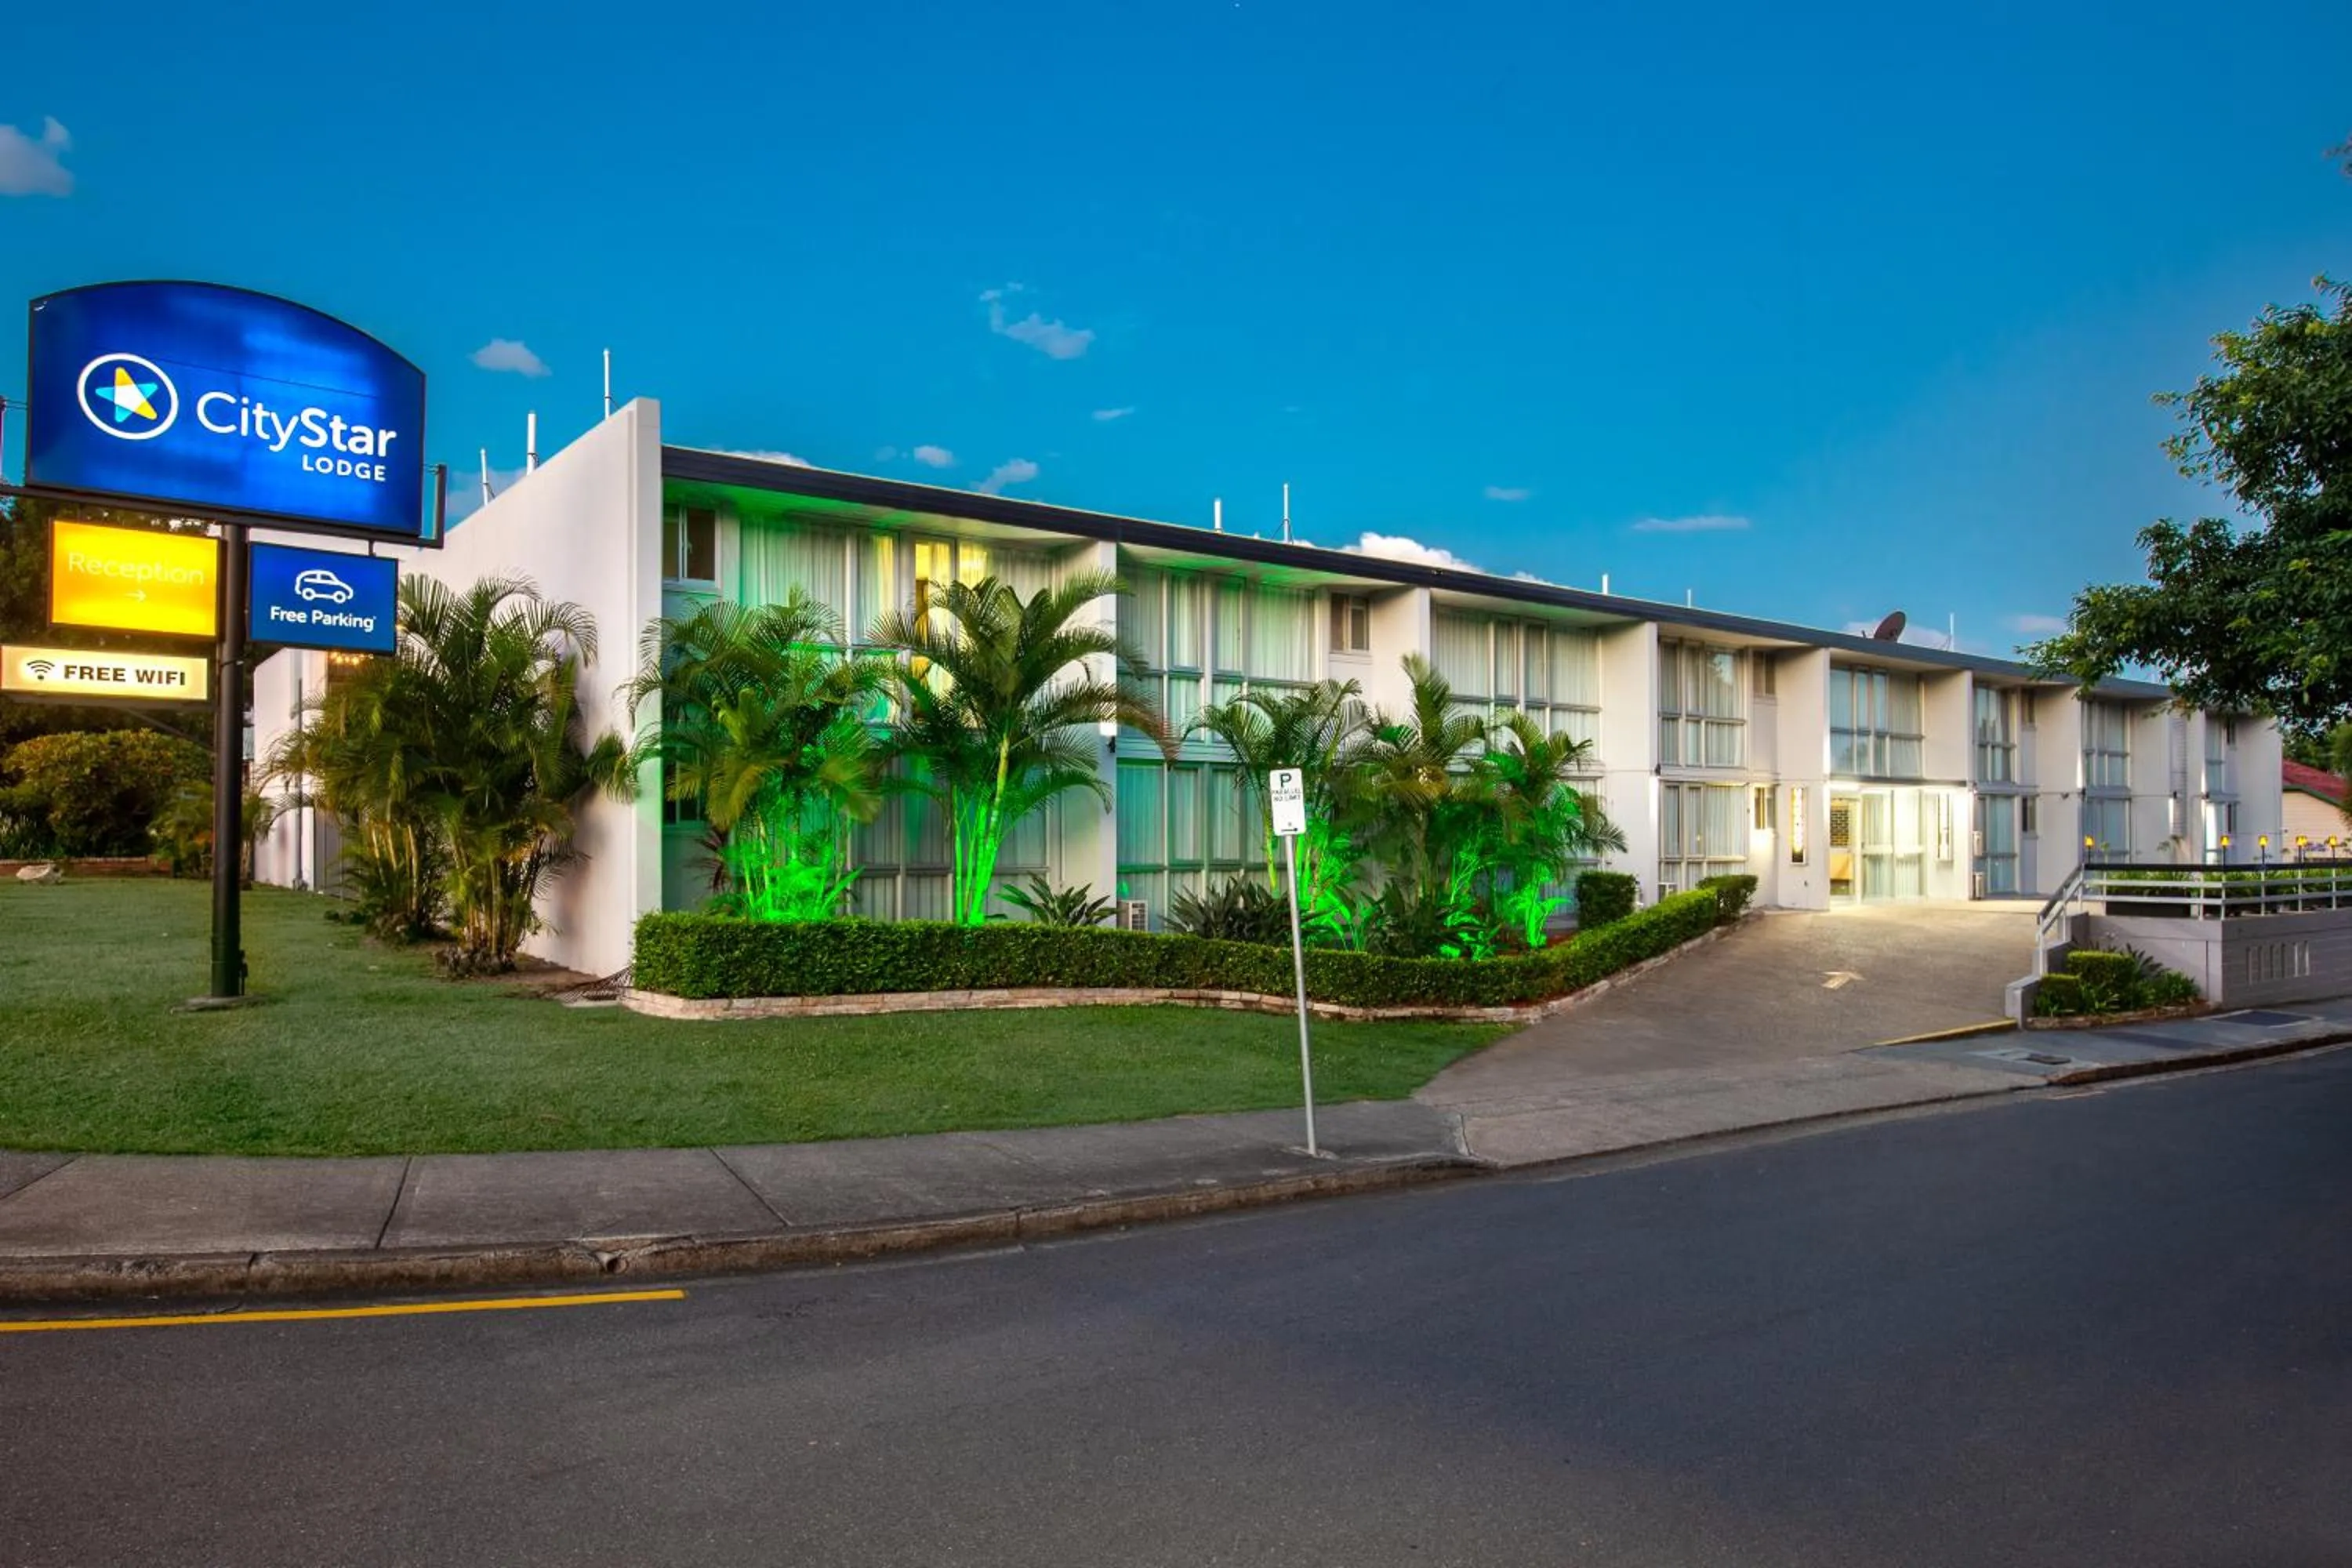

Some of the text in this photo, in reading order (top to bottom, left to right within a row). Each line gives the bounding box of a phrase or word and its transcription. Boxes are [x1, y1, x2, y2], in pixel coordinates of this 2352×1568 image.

[197, 391, 397, 457] CityStar
[302, 454, 386, 481] LODGE
[67, 551, 204, 586] Reception
[270, 605, 307, 623] Free
[64, 665, 186, 686] FREE WIFI
[1279, 772, 1292, 788] P
